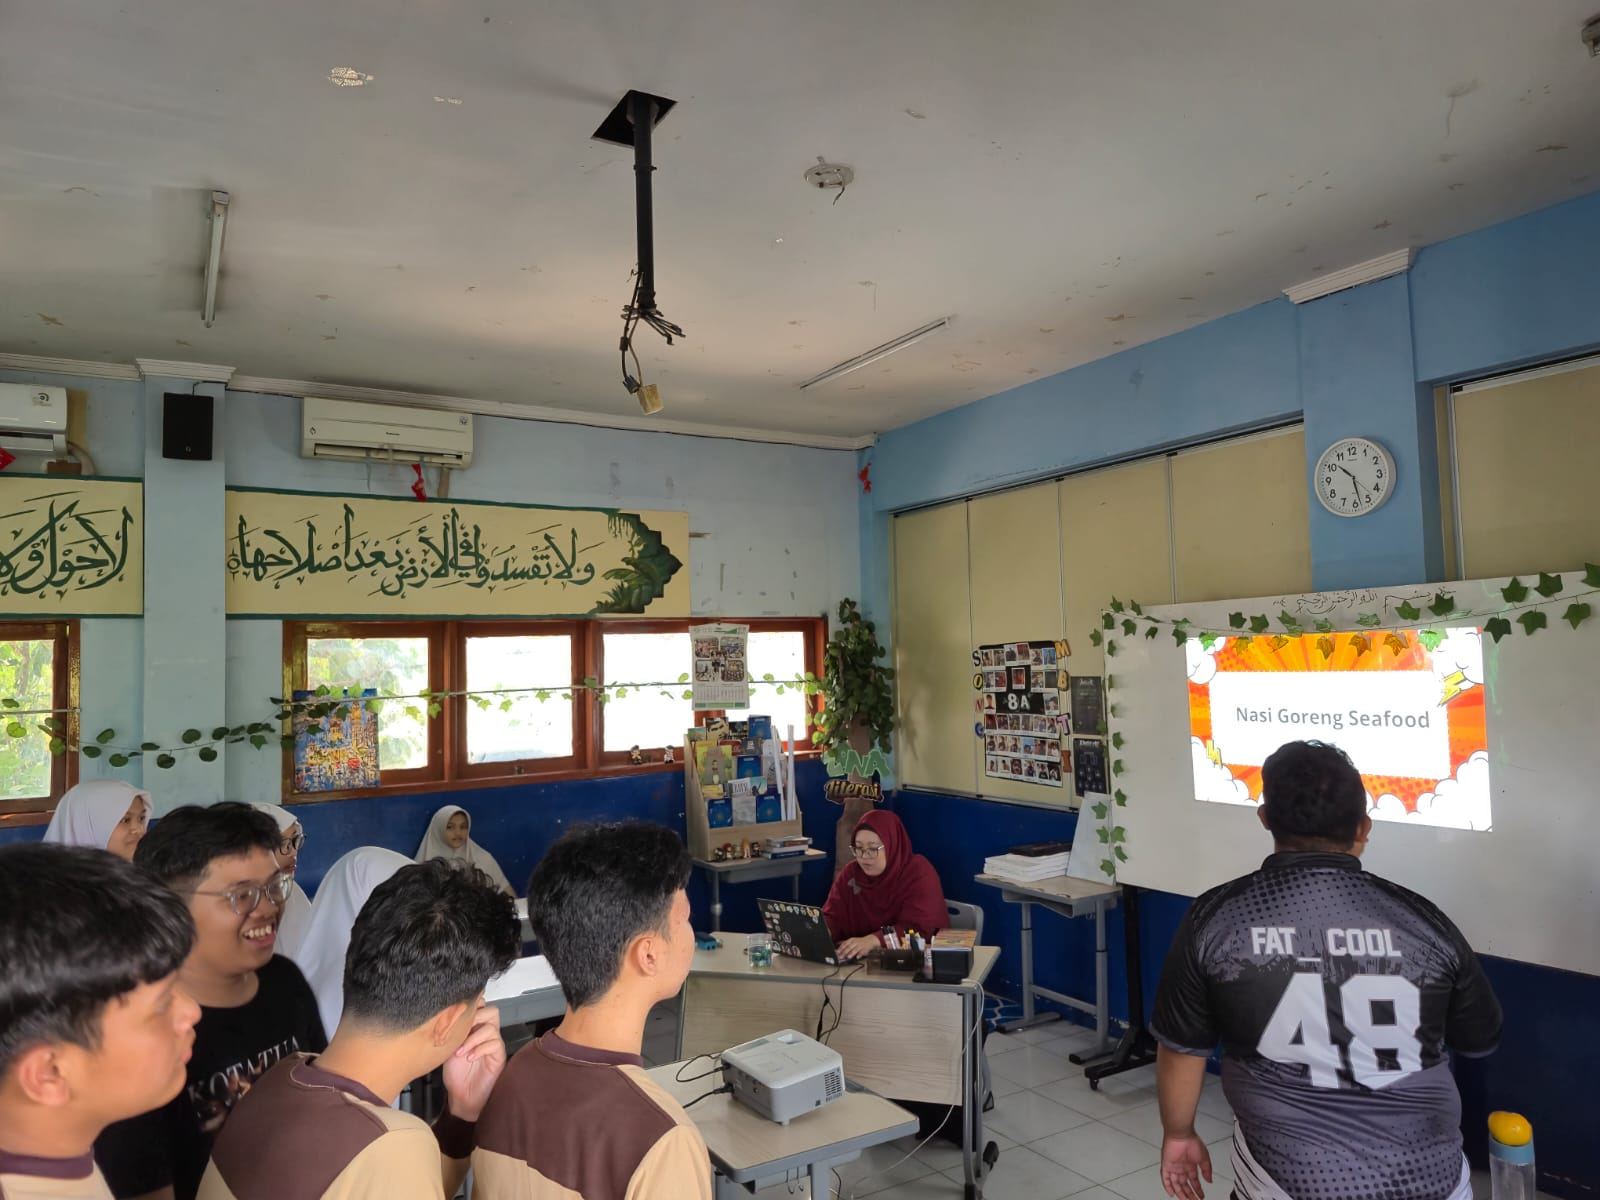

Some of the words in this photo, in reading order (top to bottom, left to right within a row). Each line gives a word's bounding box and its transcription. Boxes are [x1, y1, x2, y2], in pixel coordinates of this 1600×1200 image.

[1347, 447, 1357, 456] 12
[1336, 453, 1344, 461] 11
[1373, 456, 1378, 465] 2
[1328, 464, 1337, 472] 10
[1376, 470, 1383, 479] 3
[1325, 477, 1331, 485] 9
[1373, 483, 1380, 493] 4
[1330, 489, 1336, 498] 8
[1341, 498, 1347, 507] 7
[1365, 495, 1371, 503] 5
[1353, 500, 1359, 508] 6
[1007, 693, 1031, 711] 8A
[1236, 706, 1273, 723] Nasi
[1278, 708, 1344, 730] Goreng
[1349, 710, 1430, 728] Seafood
[1256, 973, 1423, 1090] 48
